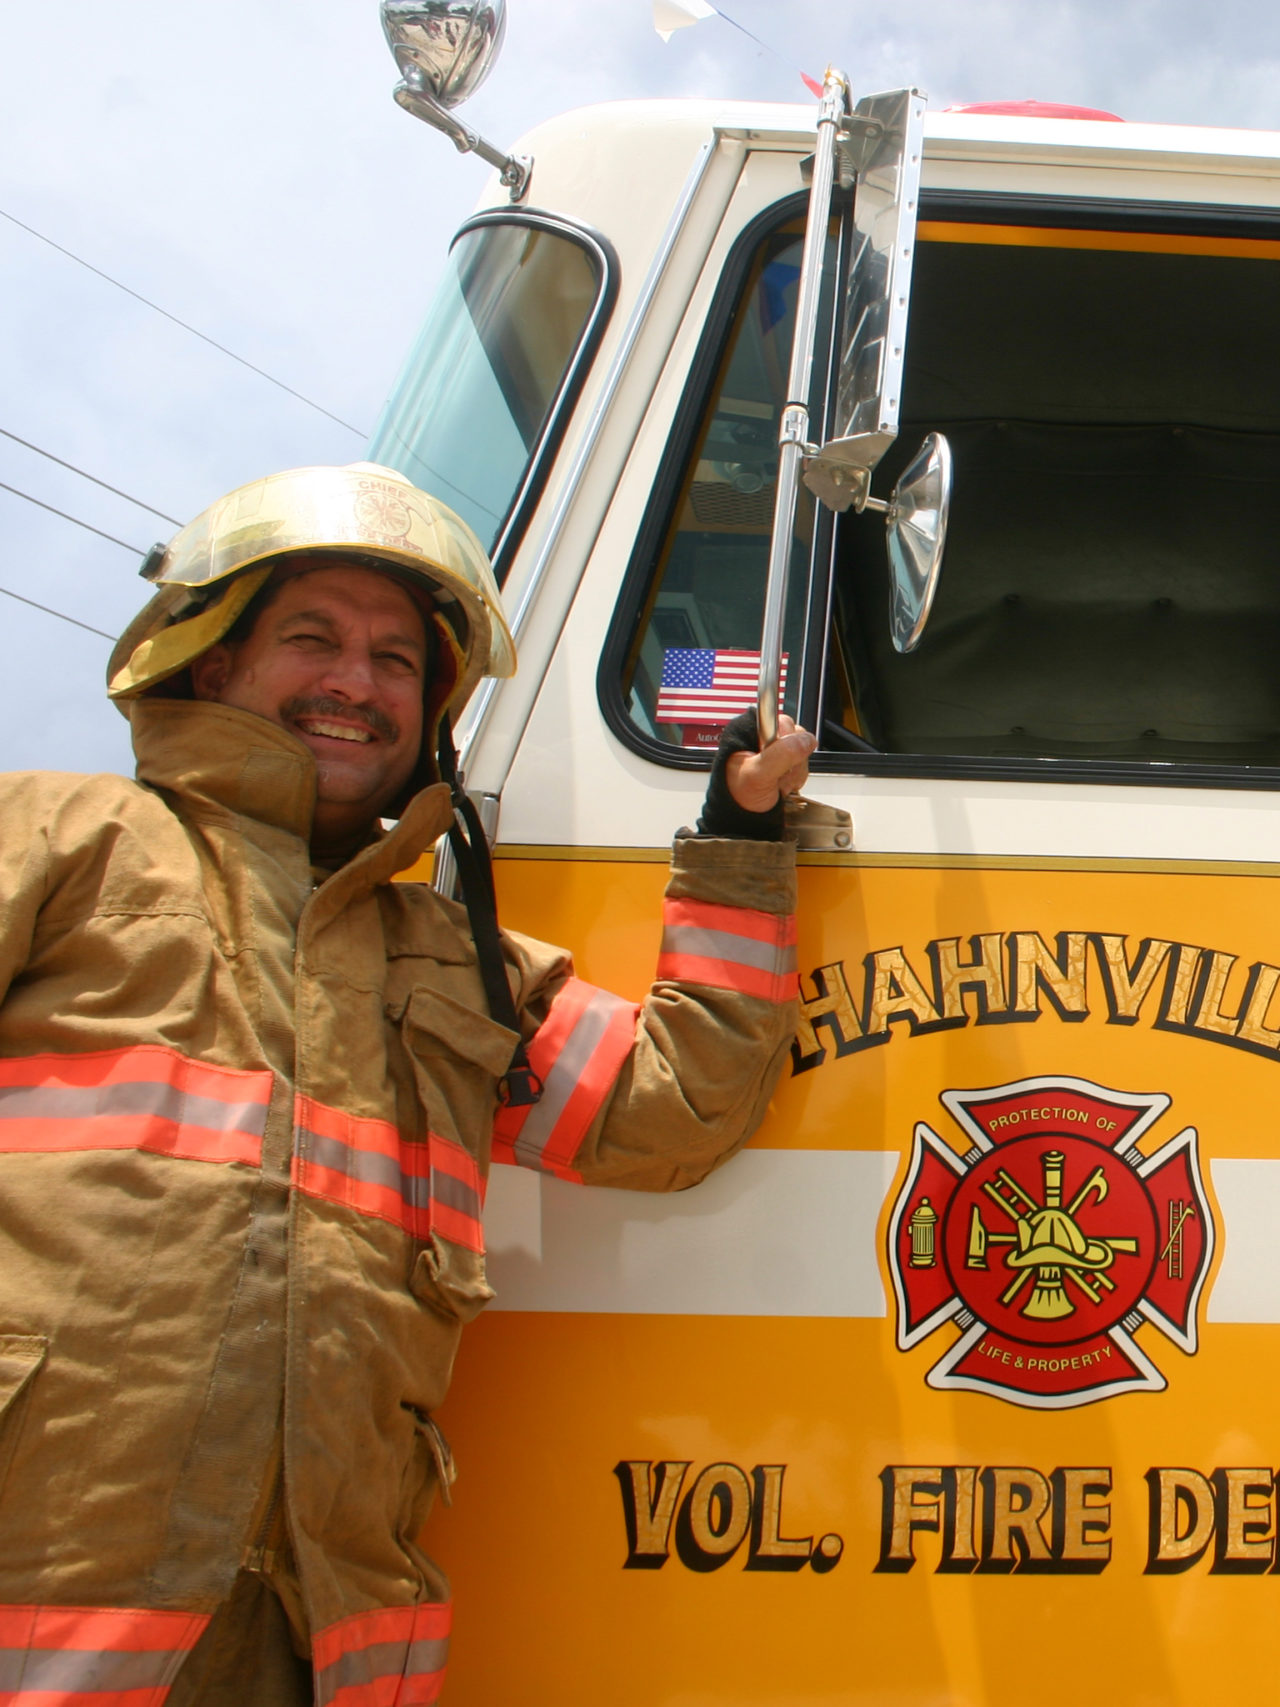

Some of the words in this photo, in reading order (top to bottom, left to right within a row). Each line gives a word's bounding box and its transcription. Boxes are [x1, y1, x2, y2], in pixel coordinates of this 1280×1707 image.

[358, 480, 408, 499] CHIEF
[989, 1107, 1089, 1132] PROTECTION
[1096, 1116, 1117, 1132] OF
[978, 1341, 1011, 1365] LIFE
[1014, 1355, 1024, 1369] &
[1027, 1345, 1112, 1372] PROPERTY
[614, 1460, 843, 1572] VOL.
[873, 1465, 1113, 1575] FIRE
